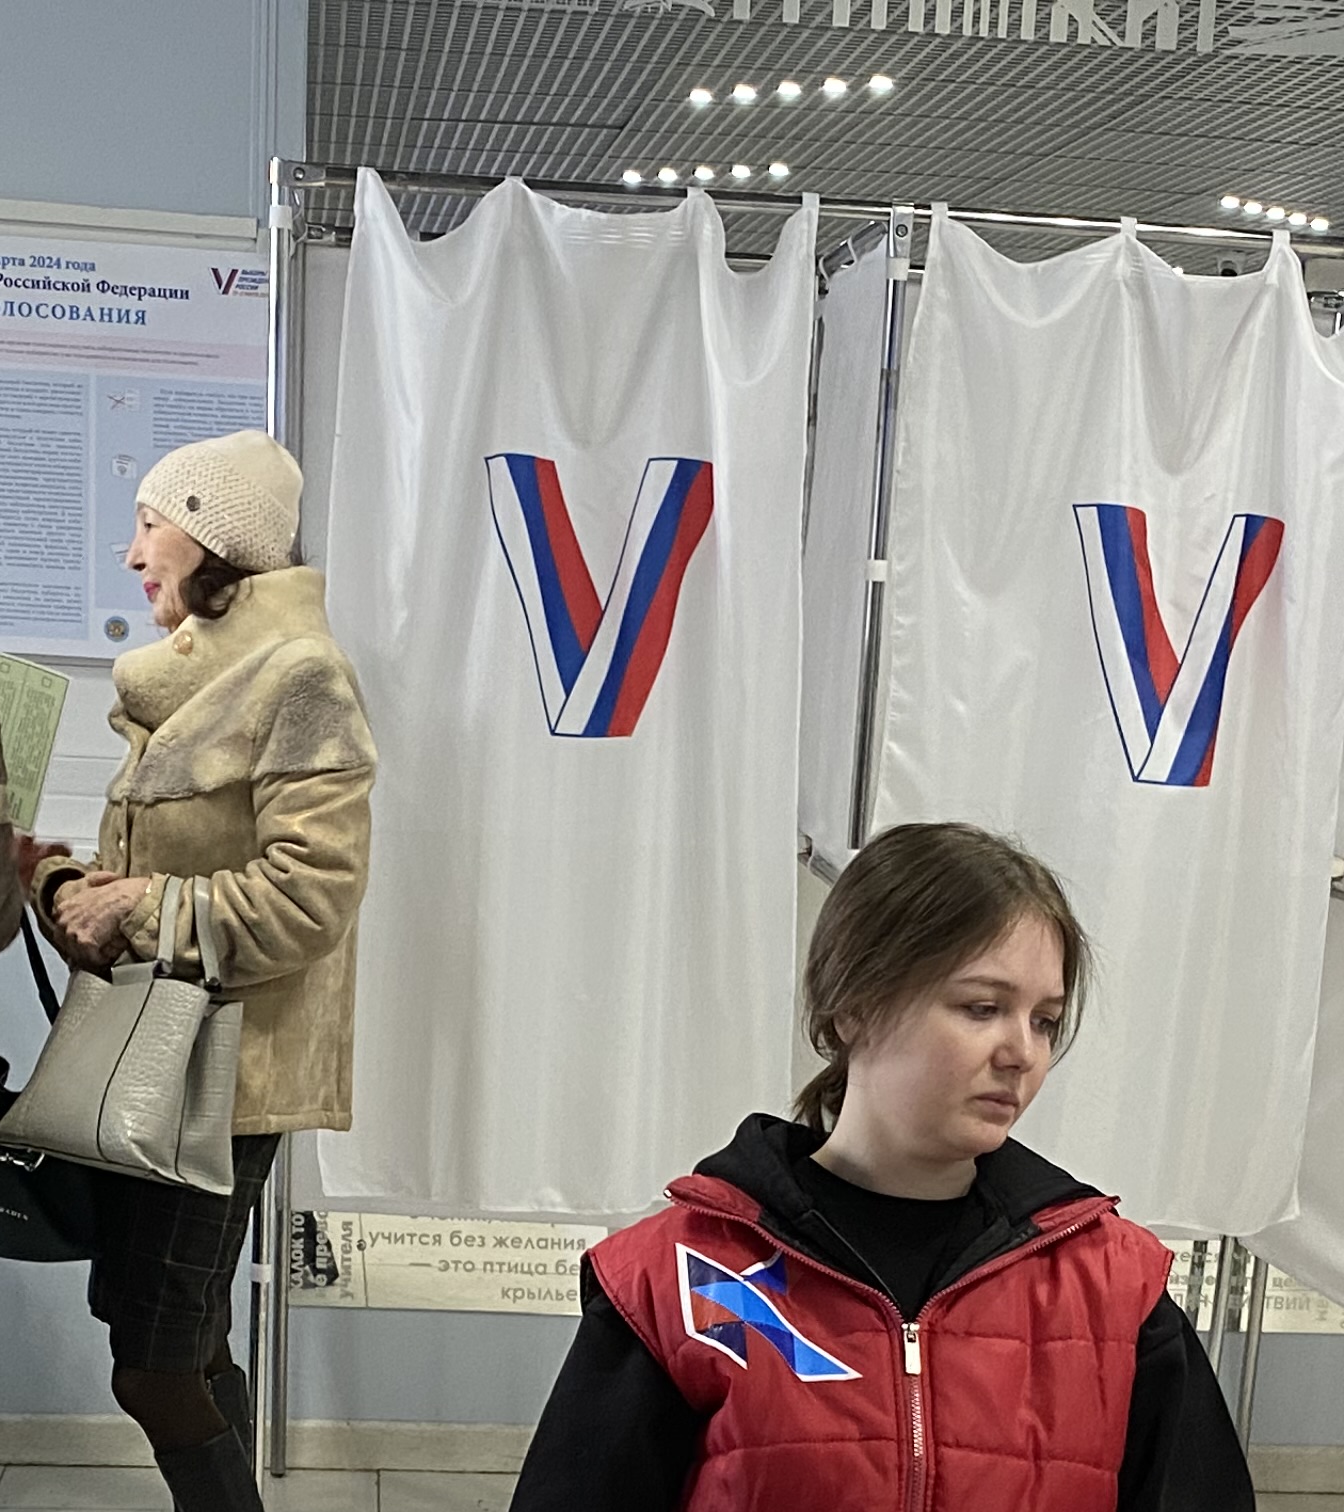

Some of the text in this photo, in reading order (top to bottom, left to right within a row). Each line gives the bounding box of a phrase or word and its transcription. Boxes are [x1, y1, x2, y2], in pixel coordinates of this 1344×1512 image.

[29, 255, 61, 269] 2024
[65, 259, 96, 273] года
[96, 279, 190, 302] Федерации
[369, 1231, 586, 1251] учится без желания
[340, 1220, 354, 1299] учителя
[438, 1258, 580, 1277] это птица бе
[501, 1286, 577, 1302] крылье
